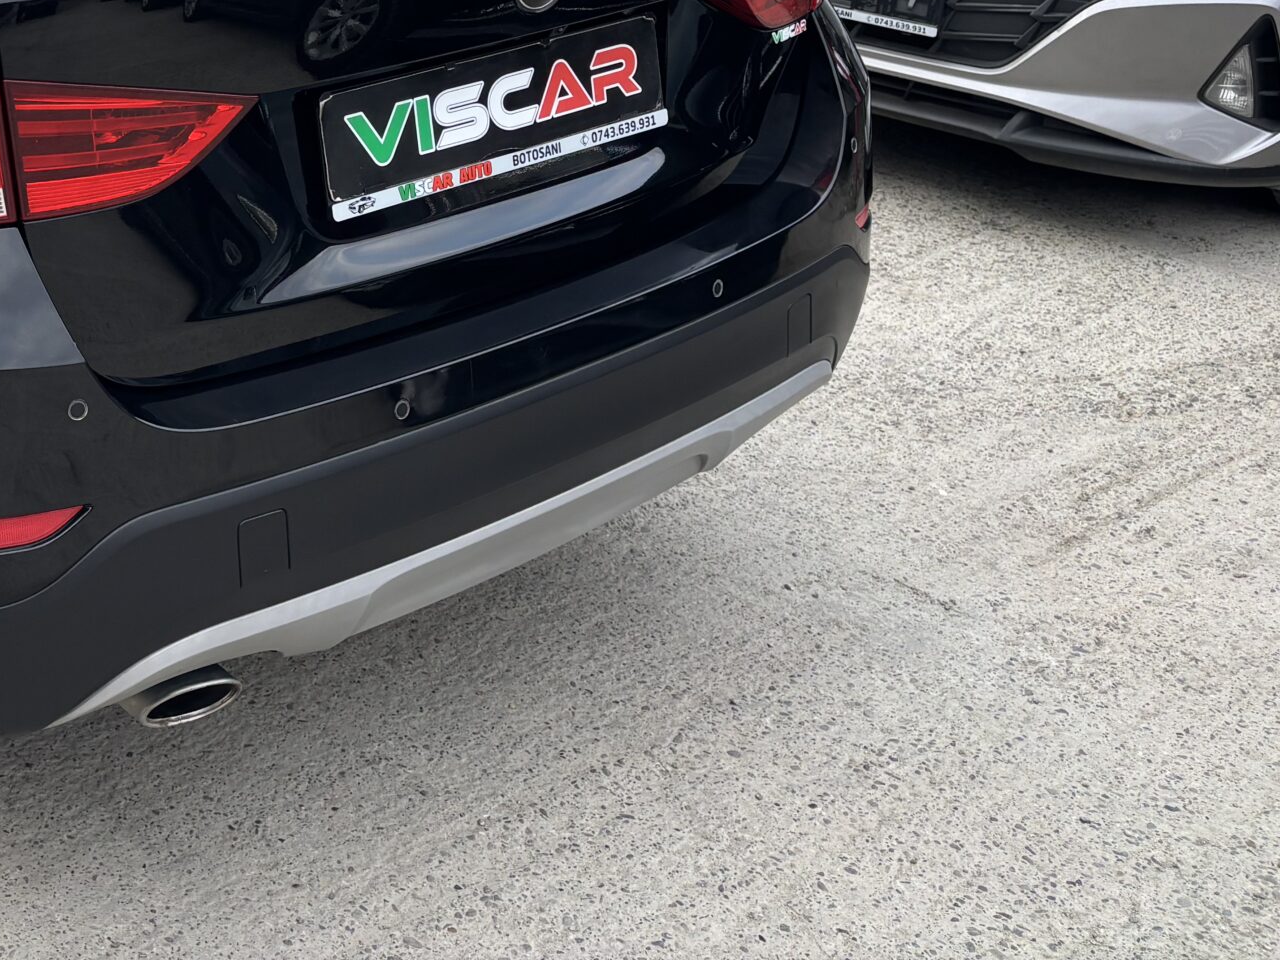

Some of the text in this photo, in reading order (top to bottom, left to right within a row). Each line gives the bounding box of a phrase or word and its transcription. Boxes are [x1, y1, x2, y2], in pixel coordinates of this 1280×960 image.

[771, 18, 807, 45] VISCAR
[874, 16, 927, 35] 0743.639.931
[344, 44, 642, 167] VISCAR
[397, 114, 657, 202] VISCAR AUTO BOTOSANI 0743.639.931
